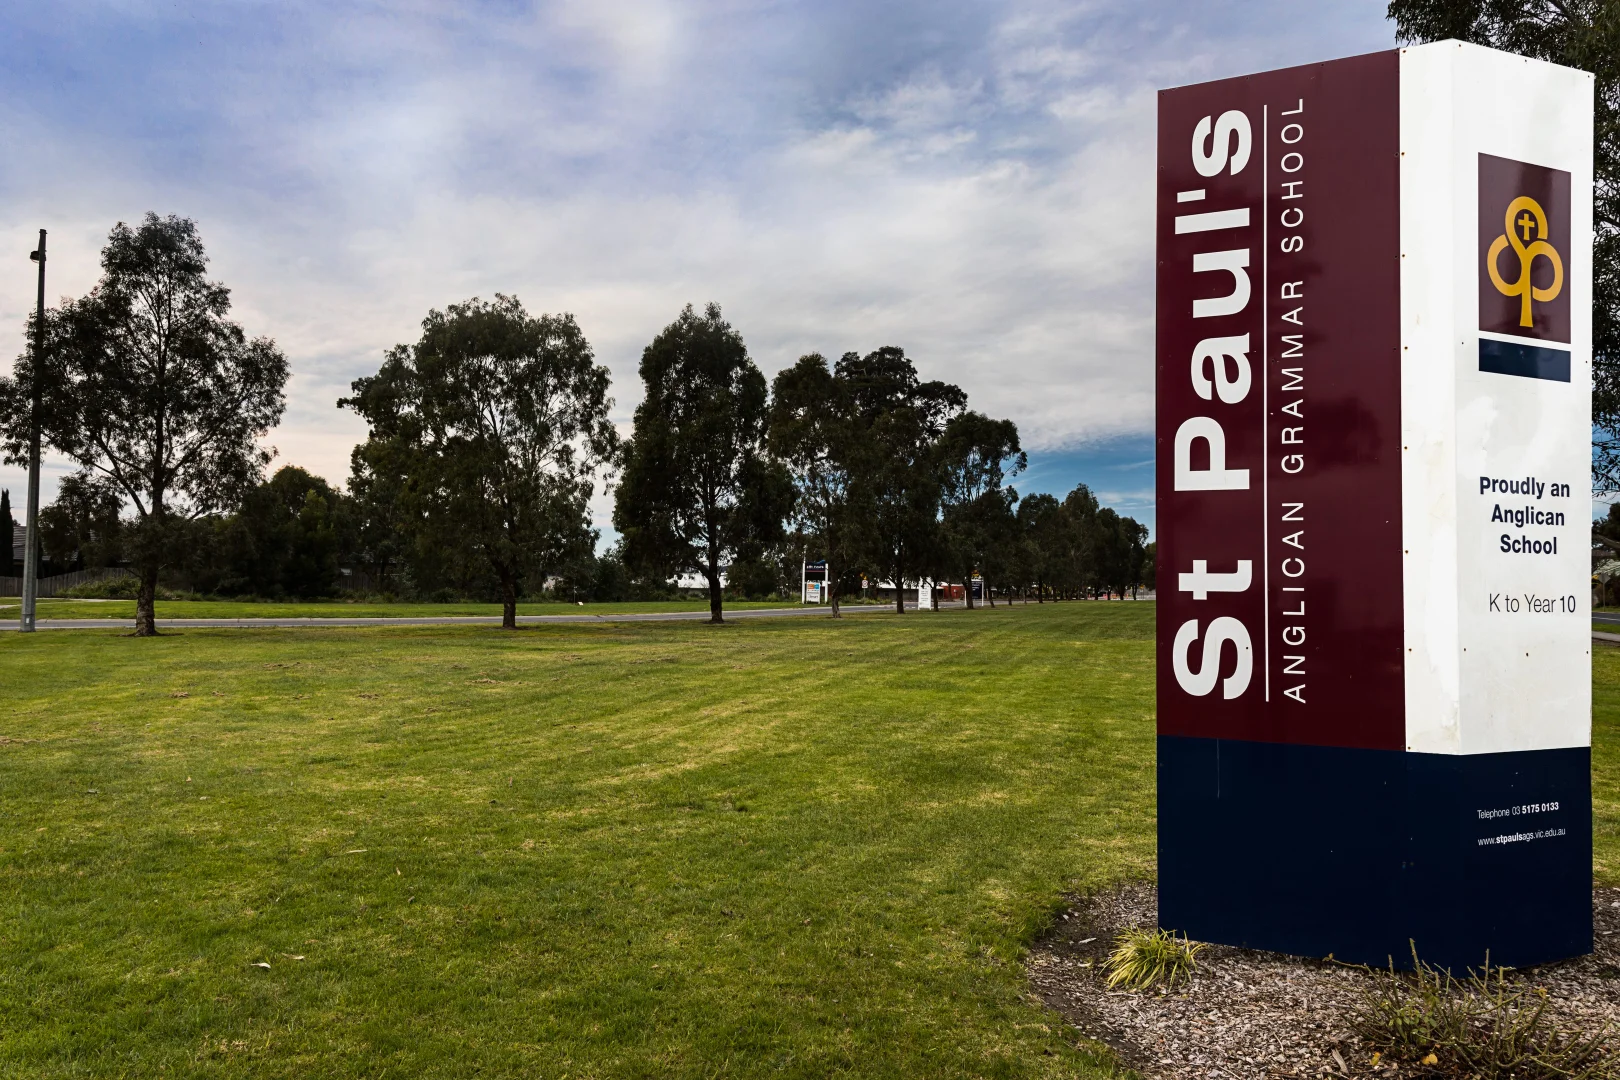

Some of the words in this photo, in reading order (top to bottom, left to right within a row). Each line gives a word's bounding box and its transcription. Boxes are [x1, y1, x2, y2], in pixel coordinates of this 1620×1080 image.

[1280, 98, 1304, 253] SCHOOL
[1174, 110, 1252, 491] Paul's
[1280, 280, 1305, 474] GRAMMAR
[1479, 476, 1545, 500] Proudly
[1550, 482, 1570, 498] an
[1491, 503, 1565, 528] Anglican
[1500, 533, 1557, 555] School
[1281, 502, 1307, 704] ANGLICAN
[1489, 593, 1501, 613] K
[1504, 594, 1520, 613] to
[1524, 593, 1556, 613] Year
[1559, 595, 1576, 613] 10
[1173, 560, 1253, 700] St
[1477, 809, 1509, 820] Telephone
[1511, 806, 1521, 816] 03
[1521, 804, 1540, 814] 5175
[1541, 802, 1559, 812] 0133
[1477, 827, 1566, 846] www.stpaulsags.vic.edu.au
